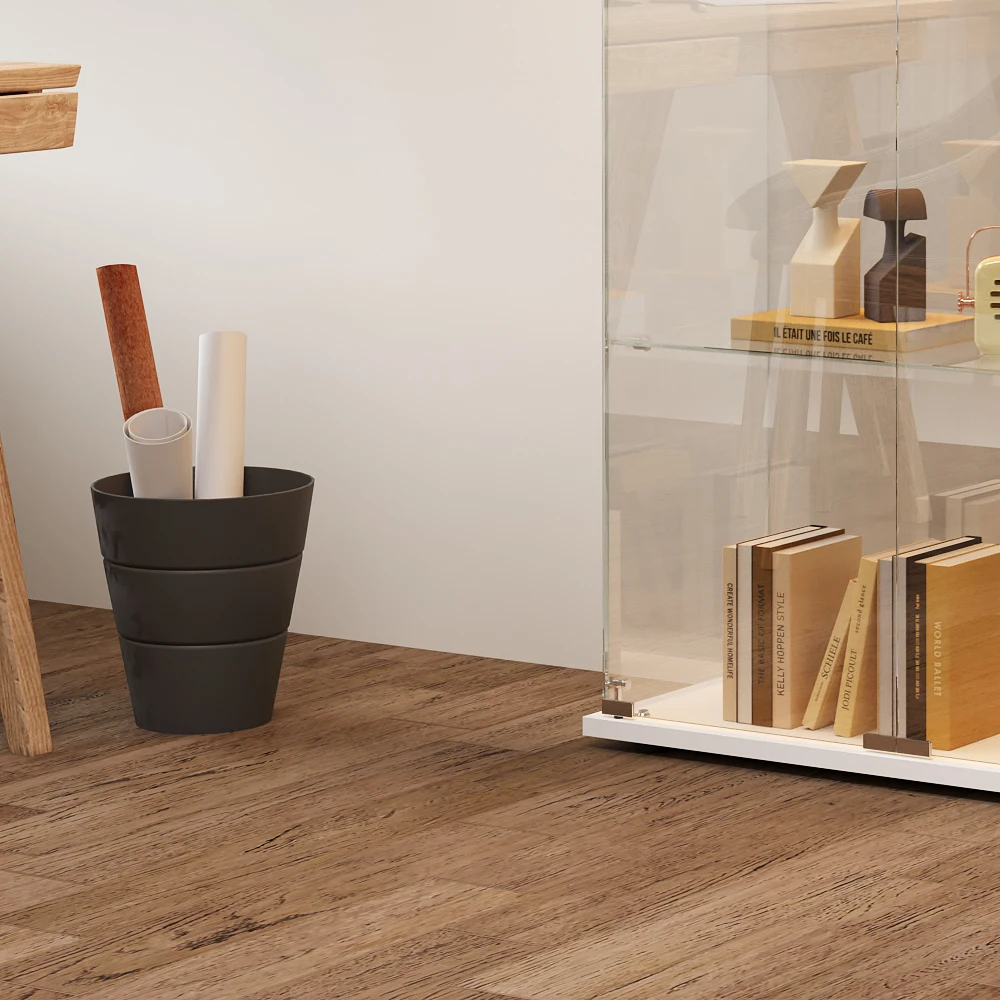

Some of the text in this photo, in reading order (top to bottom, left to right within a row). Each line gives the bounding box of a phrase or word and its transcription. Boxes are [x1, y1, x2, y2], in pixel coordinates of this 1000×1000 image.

[774, 324, 873, 345] IL ÉTAIT UNE FOIS LE CAFÉ
[858, 584, 867, 608] glance
[758, 625, 765, 637] OF
[777, 592, 785, 696] KELLY HOPPEN STYLE
[821, 636, 841, 680] SCHIELE
[845, 648, 858, 687] PICOULT
[933, 621, 942, 697] WORLD BALLET
[841, 688, 851, 711] JODI
